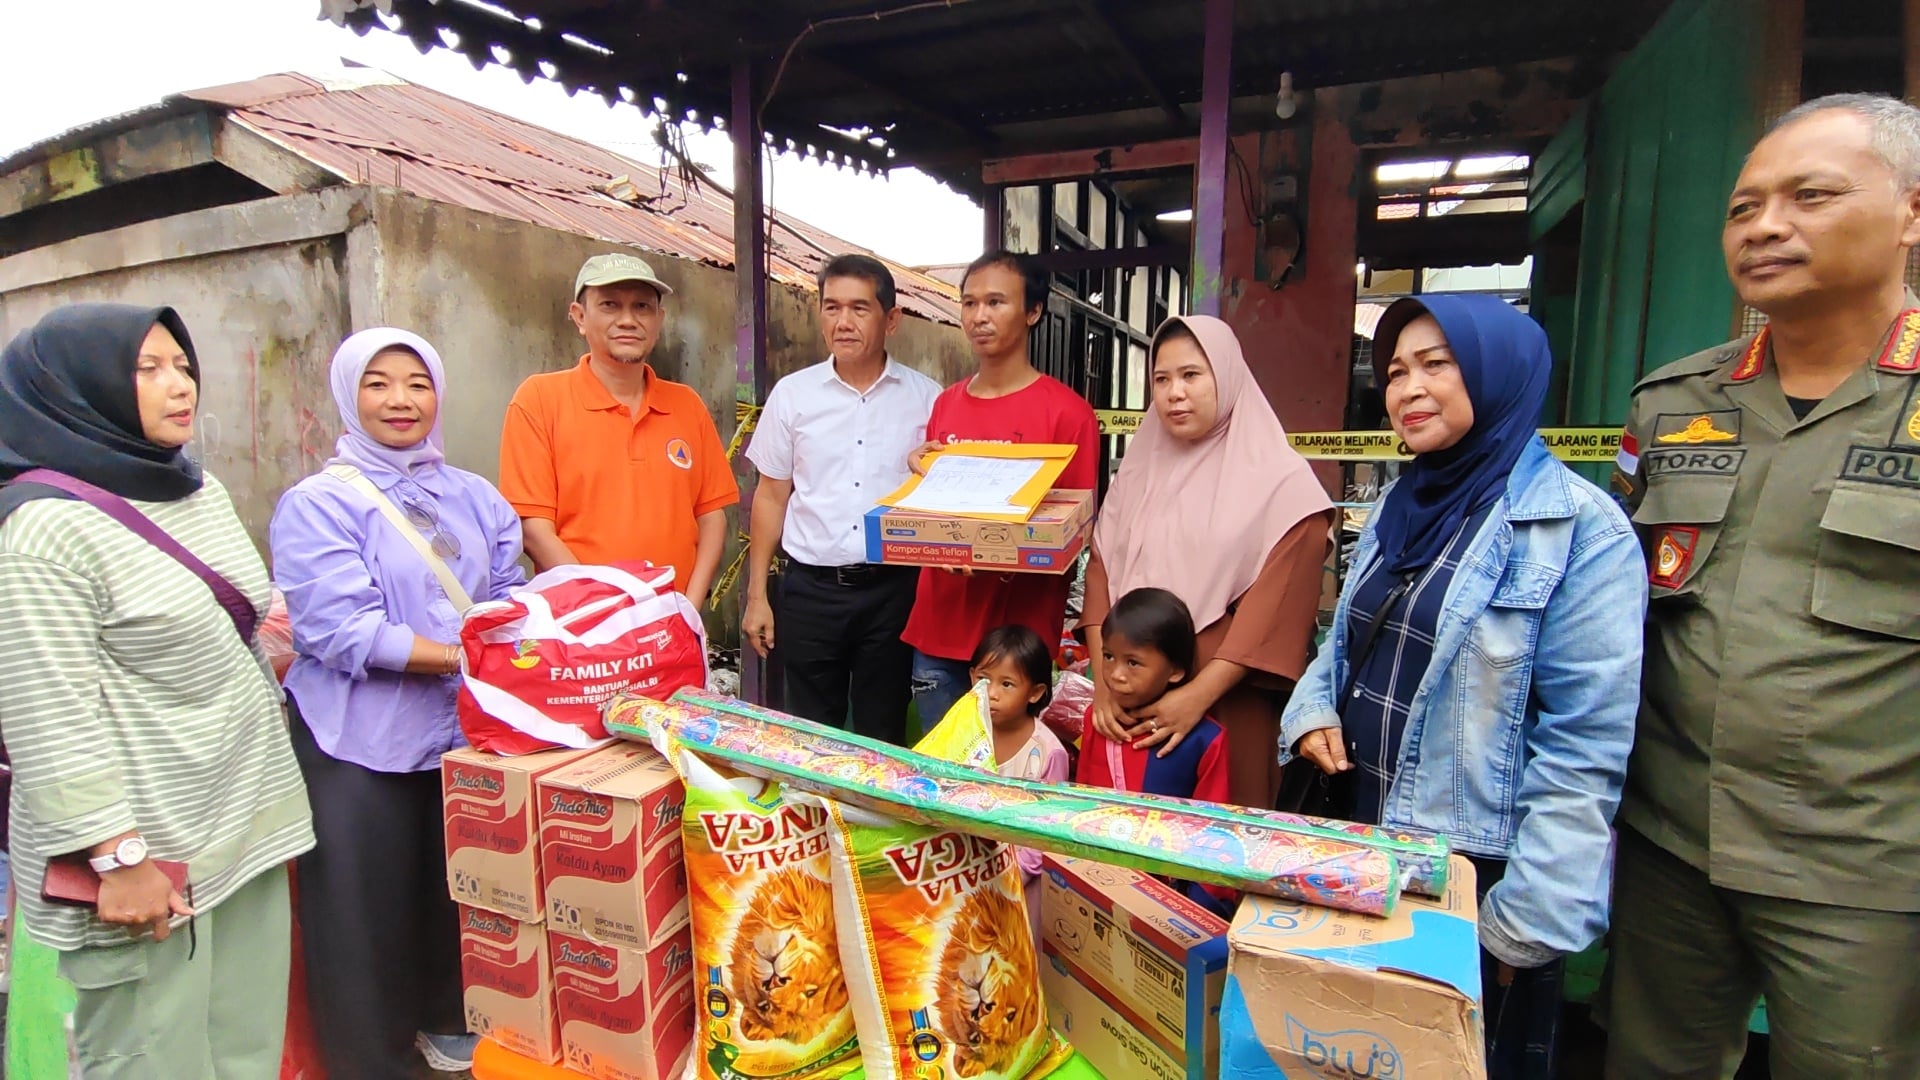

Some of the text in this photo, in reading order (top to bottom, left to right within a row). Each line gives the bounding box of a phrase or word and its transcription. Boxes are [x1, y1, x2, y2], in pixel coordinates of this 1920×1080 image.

[1111, 416, 1137, 427] GARIS
[1295, 435, 1392, 446] DILARANG MELINTAS
[1600, 435, 1621, 447] ME
[1599, 449, 1618, 457] CROS
[1653, 453, 1733, 470] TORO
[1854, 452, 1919, 481] POL
[886, 543, 968, 557] Kompor Gas Teflon
[550, 653, 653, 681] FAMILY KIT
[583, 679, 630, 695] BANTUAN
[648, 677, 658, 687] RI
[559, 829, 592, 844] Mi Instan
[556, 851, 627, 878] Kaldu Ayam
[886, 832, 999, 882] NGA
[1164, 898, 1183, 910] Gas
[1181, 908, 1221, 934] Kompor
[1100, 1017, 1127, 1048] Stove
[1128, 1041, 1148, 1065] Gas
